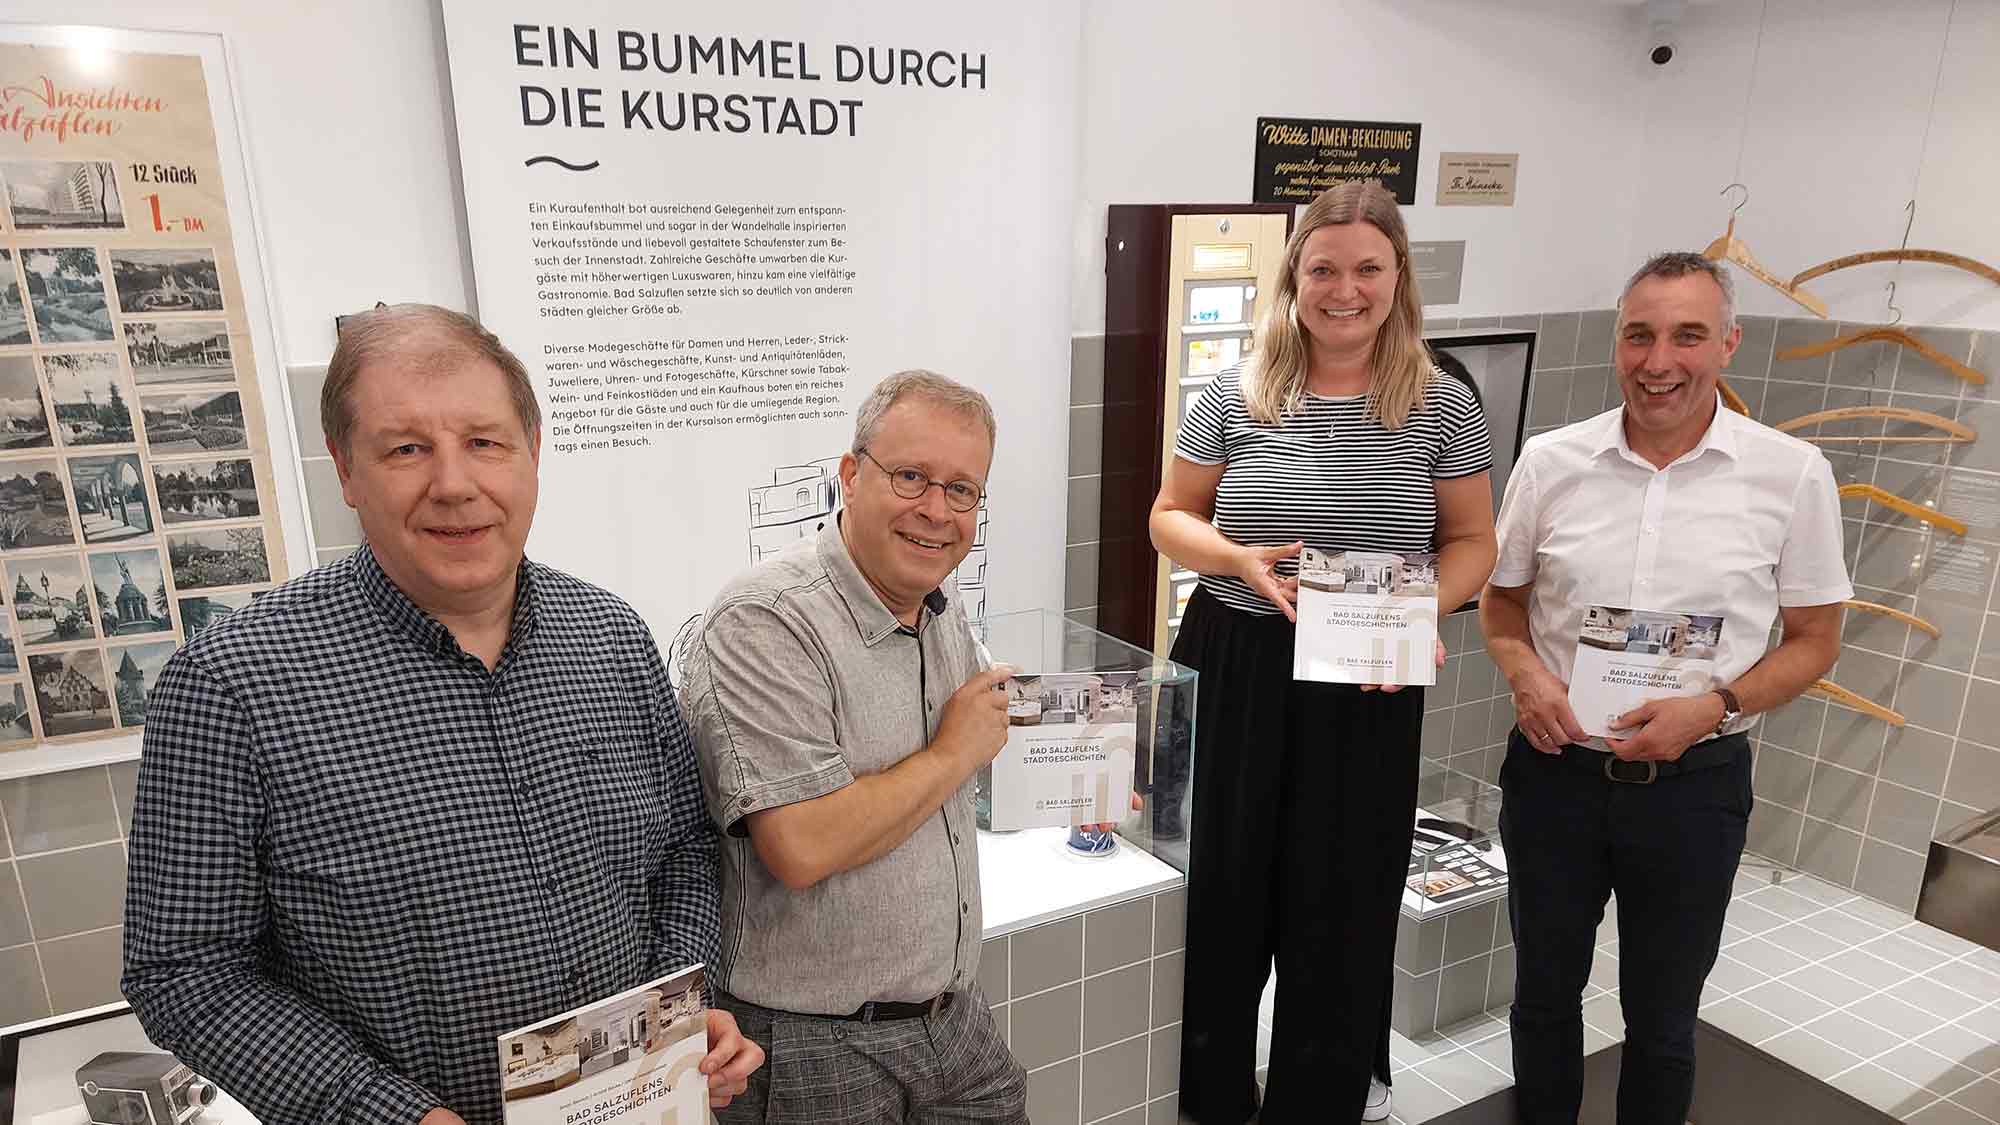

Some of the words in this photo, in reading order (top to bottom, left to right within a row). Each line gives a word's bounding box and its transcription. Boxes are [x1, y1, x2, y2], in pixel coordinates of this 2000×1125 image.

[513, 24, 600, 70] EIN
[617, 29, 821, 81] BUMMEL
[835, 44, 987, 89] DURCH
[3, 74, 168, 112] Ansichten
[520, 85, 605, 129] DIE
[621, 89, 864, 137] KURSTADT
[0, 105, 121, 144] alzuflen
[1263, 124, 1309, 145] Witte
[1311, 127, 1413, 150] DAMEN-BEKLEIDUNG
[128, 164, 150, 183] 12
[154, 163, 197, 184] Stück
[528, 202, 546, 213] Ein
[549, 202, 625, 213] Kuraufenthalt
[628, 203, 647, 213] bot
[649, 203, 712, 214] ausreichend
[714, 203, 774, 216] Gelegenheit
[776, 207, 796, 216] zum
[798, 206, 846, 216] entspann-
[184, 218, 205, 232] DM
[530, 221, 549, 230] ten
[552, 219, 642, 232] Einkaufsbummel
[645, 220, 665, 231] und
[668, 223, 696, 233] sogar
[699, 220, 708, 230] in
[711, 220, 728, 230] der
[730, 220, 790, 231] Wandelhalle
[793, 222, 846, 232] inspirierten
[531, 237, 618, 248] Verkaufsstände
[621, 237, 642, 247] und
[644, 236, 686, 247] liebevoll
[689, 237, 740, 249] gestaltete
[743, 237, 805, 247] Schaufenster
[807, 239, 828, 247] zum
[830, 237, 846, 247] Be-
[534, 255, 560, 265] such
[562, 255, 581, 265] der
[584, 255, 646, 264] Innenstadt.
[649, 253, 702, 264] Zahlreiche
[704, 253, 756, 263] Geschäfte
[758, 253, 807, 263] umwarben
[809, 253, 825, 263] die
[828, 253, 847, 263] Kur-
[536, 271, 567, 285] gäste
[570, 271, 588, 282] mit
[591, 271, 669, 283] höherwertigen
[671, 271, 734, 281] Luxuswaren,
[736, 269, 763, 280] hinzu
[765, 270, 785, 279] kam
[787, 270, 807, 279] eine
[809, 268, 856, 280] vielfältige
[537, 288, 611, 300] Gastronomie.
[613, 287, 635, 298] Bad
[638, 287, 684, 297] Salzuflen
[686, 287, 717, 296] setzte
[719, 286, 739, 296] sich
[756, 285, 793, 295] deutlich
[814, 284, 853, 294] anderen
[539, 306, 584, 317] Städten
[586, 305, 628, 318] gleicher
[631, 304, 664, 314] Größe
[666, 303, 682, 313] ab.
[543, 343, 585, 354] Diverse
[588, 340, 669, 353] Modegeschäfte
[671, 339, 685, 349] für
[687, 339, 723, 348] Damen
[725, 337, 745, 347] und
[747, 337, 783, 346] Herren,
[818, 334, 849, 343] Strick-
[545, 362, 583, 370] waren-
[586, 359, 607, 368] und
[608, 354, 702, 368] Wäschegeschäfte,
[704, 354, 736, 363] Kunst-
[739, 351, 758, 362] und
[761, 348, 845, 362] Antiquitätenläden,
[547, 375, 602, 387] Juweliere,
[605, 375, 639, 384] Uhren-
[642, 372, 662, 382] und
[665, 369, 738, 382] Fotogeschäfte,
[741, 367, 788, 377] Kürschner
[790, 365, 815, 375] sowie
[548, 392, 580, 403] Wein-
[583, 391, 604, 401] und
[606, 388, 678, 400] Feinkostläden
[680, 386, 698, 396] und
[700, 385, 716, 395] ein
[718, 384, 765, 394] Kaufhaus
[767, 383, 793, 392] boten
[794, 380, 808, 390] ein
[810, 379, 844, 388] reiches
[551, 408, 596, 421] Angebot
[600, 407, 614, 416] für
[617, 405, 633, 415] die
[635, 404, 667, 416] Gäste
[669, 402, 687, 412] und
[689, 401, 713, 411] auch
[716, 399, 730, 409] für
[732, 399, 748, 408] die
[750, 395, 803, 408] umliegende
[805, 393, 839, 405] Region.
[552, 425, 570, 435] Die
[573, 420, 652, 434] Öffnungszeiten
[655, 420, 664, 429] in
[666, 419, 683, 428] der
[685, 415, 733, 427] Kursaison
[735, 413, 796, 424] ermöglichten
[798, 409, 820, 419] auch
[554, 442, 578, 453] tags
[580, 439, 610, 450] einen
[612, 435, 651, 447] Besuch.
[1326, 618, 1408, 628] STADTGESCHICHTEN
[1351, 612, 1401, 621] SALZUFLENS
[1601, 676, 1682, 689] STADTGESCHICHTEN
[1628, 671, 1677, 682] SALZUFLENS
[1030, 747, 1047, 755] BAD
[1049, 745, 1100, 754] SALZUFLENS
[1023, 754, 1106, 764] STADTGESCHICHTEN
[566, 1108, 591, 1124] BAD
[594, 1077, 663, 1113] SALZUFLENS
